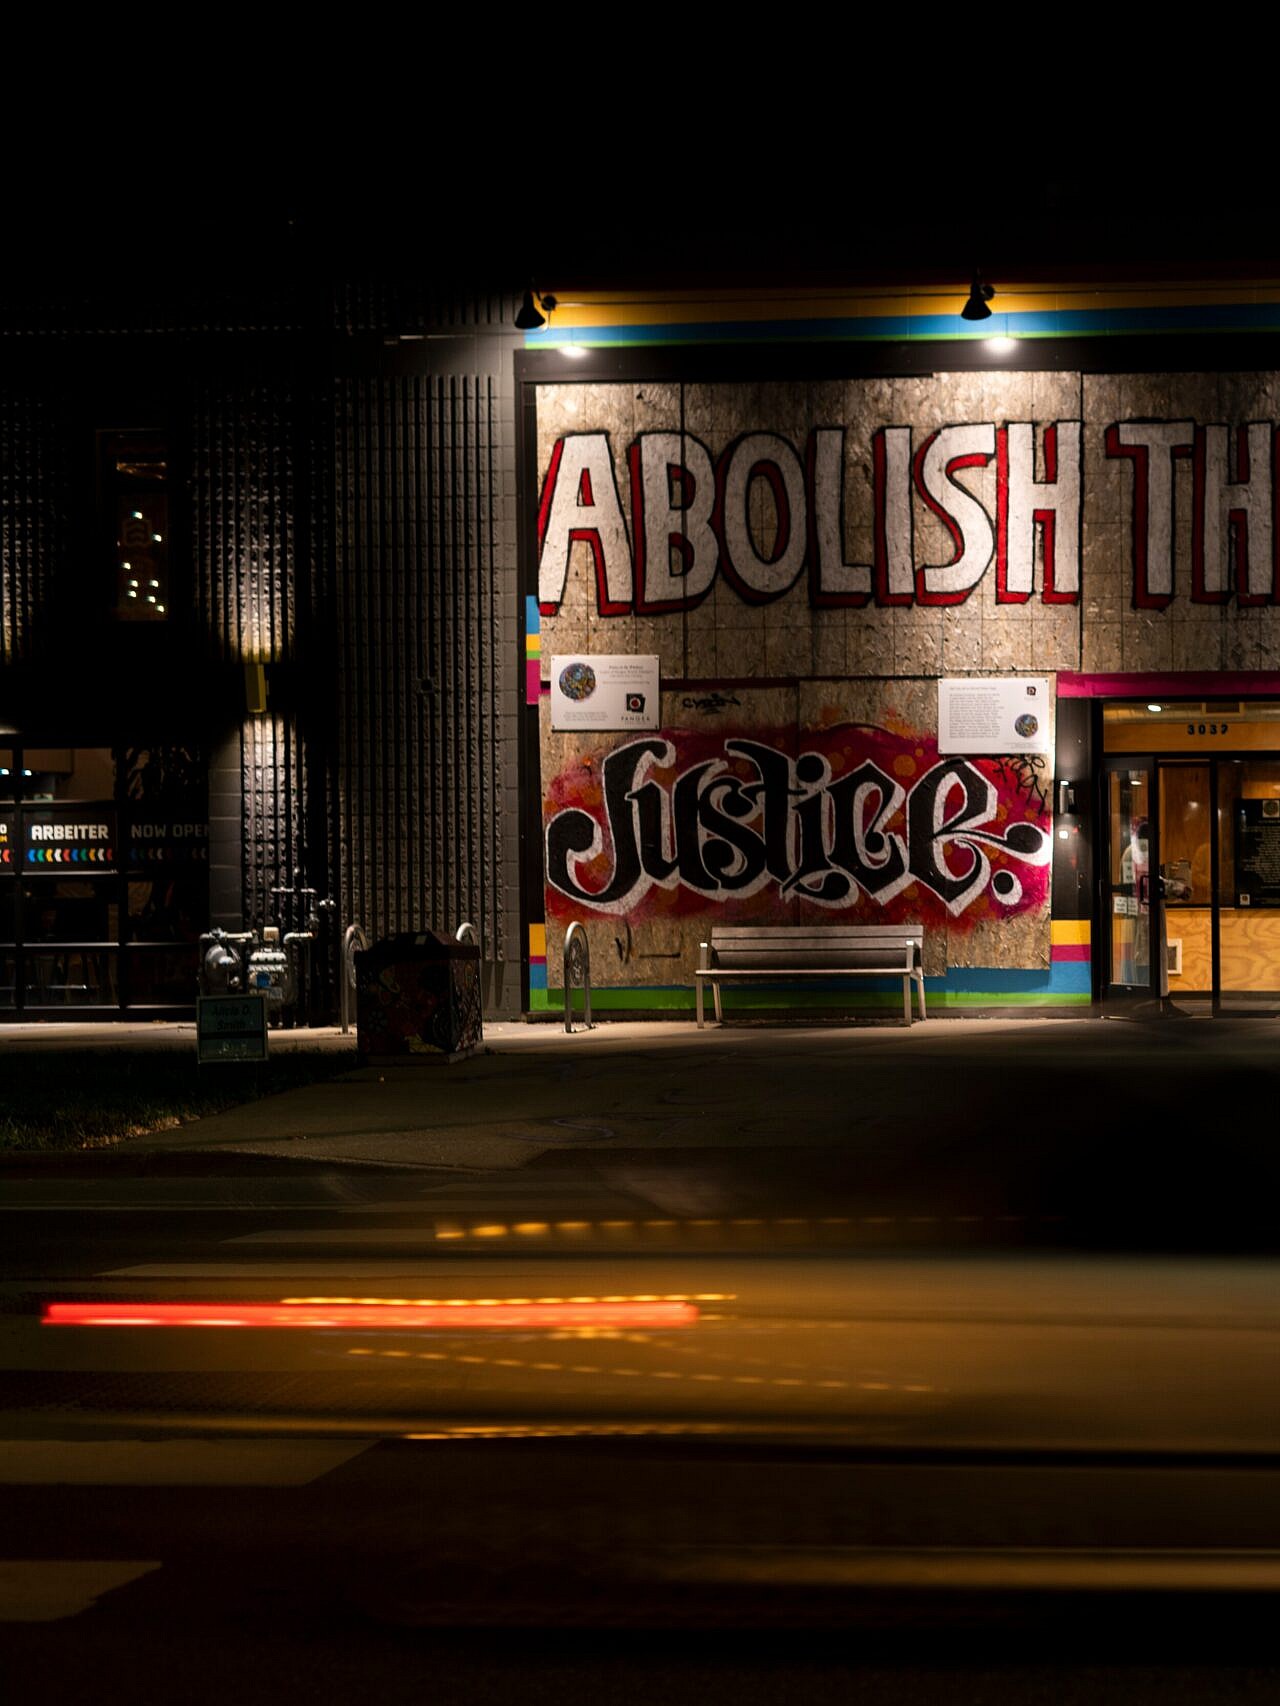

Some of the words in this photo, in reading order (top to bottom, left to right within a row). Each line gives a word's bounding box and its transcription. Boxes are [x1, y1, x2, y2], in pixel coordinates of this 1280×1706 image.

[538, 420, 1085, 617] ABOLISH
[1187, 724, 1229, 736] 3037
[31, 824, 110, 841] ARBEITER
[130, 823, 168, 839] NOW
